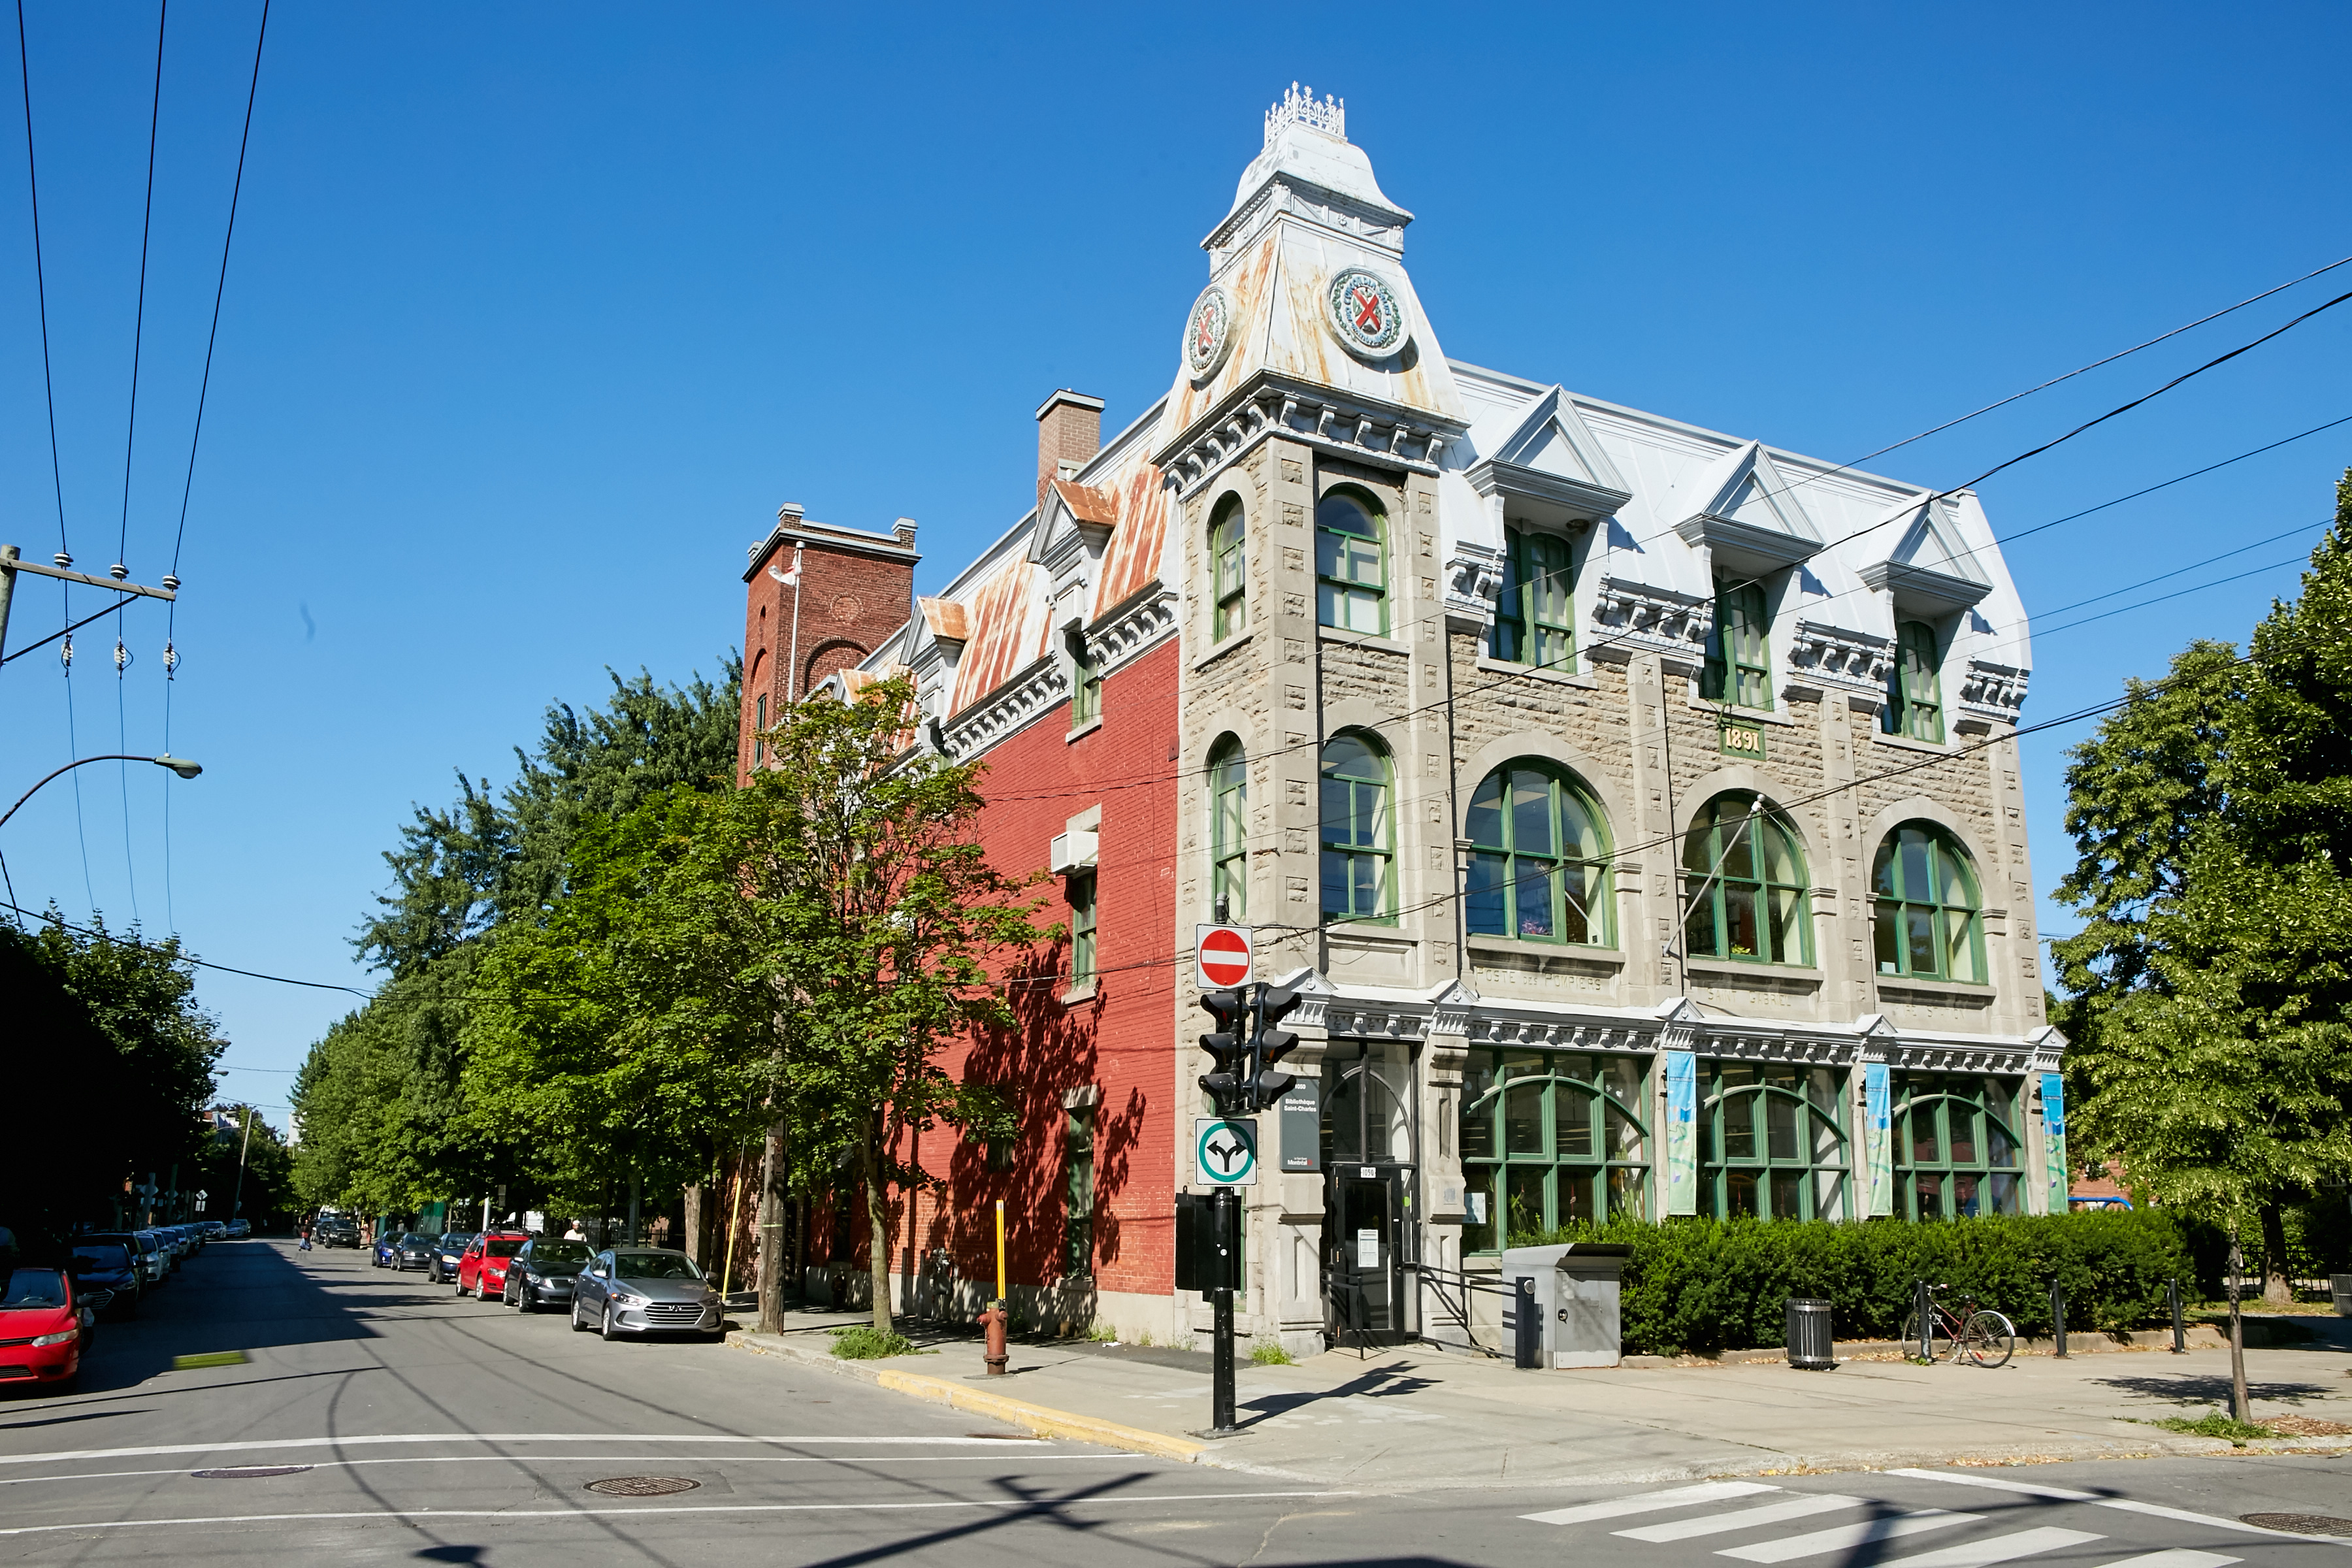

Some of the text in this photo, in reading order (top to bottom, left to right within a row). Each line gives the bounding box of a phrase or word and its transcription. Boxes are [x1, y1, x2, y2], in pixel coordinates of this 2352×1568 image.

[1725, 727, 1759, 751] 1891
[1475, 966, 1516, 983] POSTE
[1544, 973, 1601, 990] POMPIERS
[1707, 987, 1791, 1007] SAINT GABRIEL
